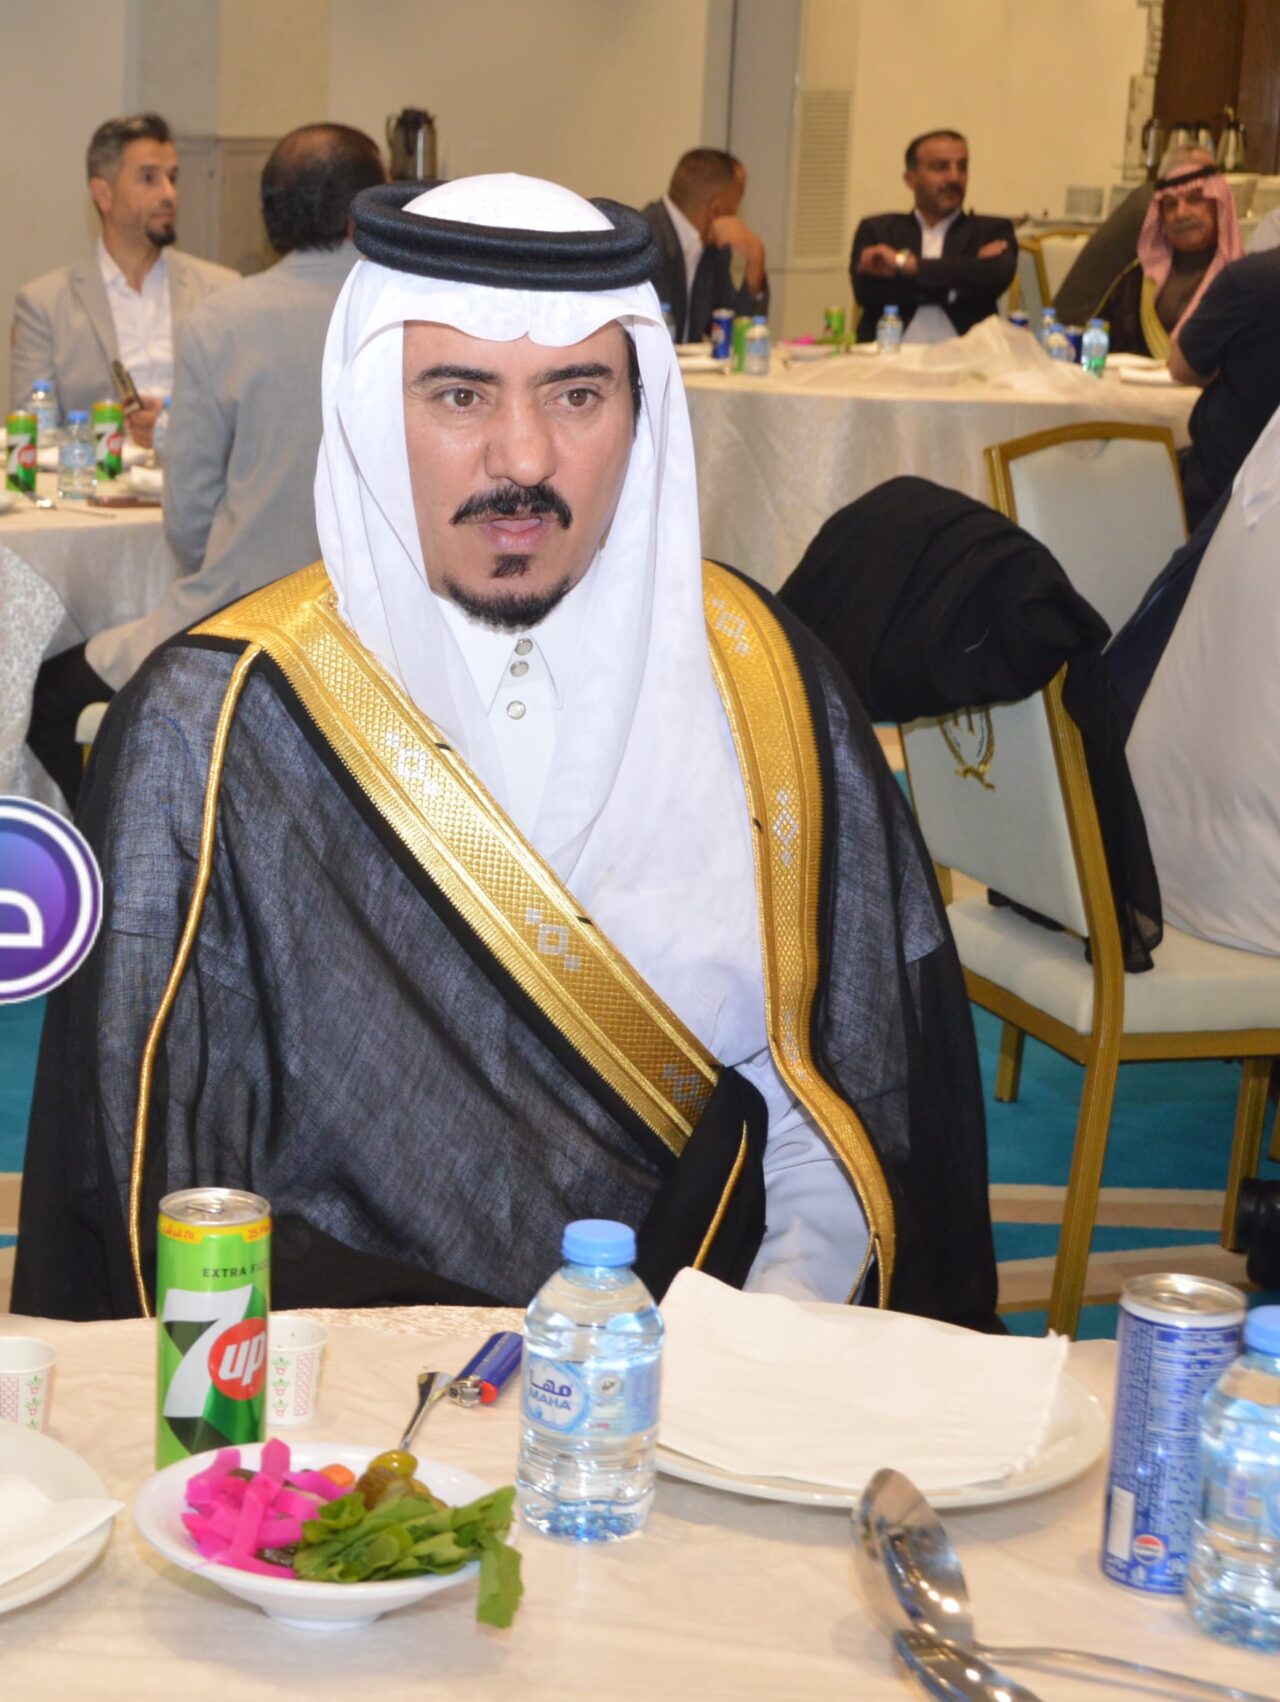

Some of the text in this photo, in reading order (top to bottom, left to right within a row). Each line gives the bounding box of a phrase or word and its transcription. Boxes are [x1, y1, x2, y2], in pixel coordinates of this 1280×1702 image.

[202, 1266, 248, 1279] EXTRA
[529, 1368, 573, 1398] مها
[529, 1386, 572, 1411] MAHA
